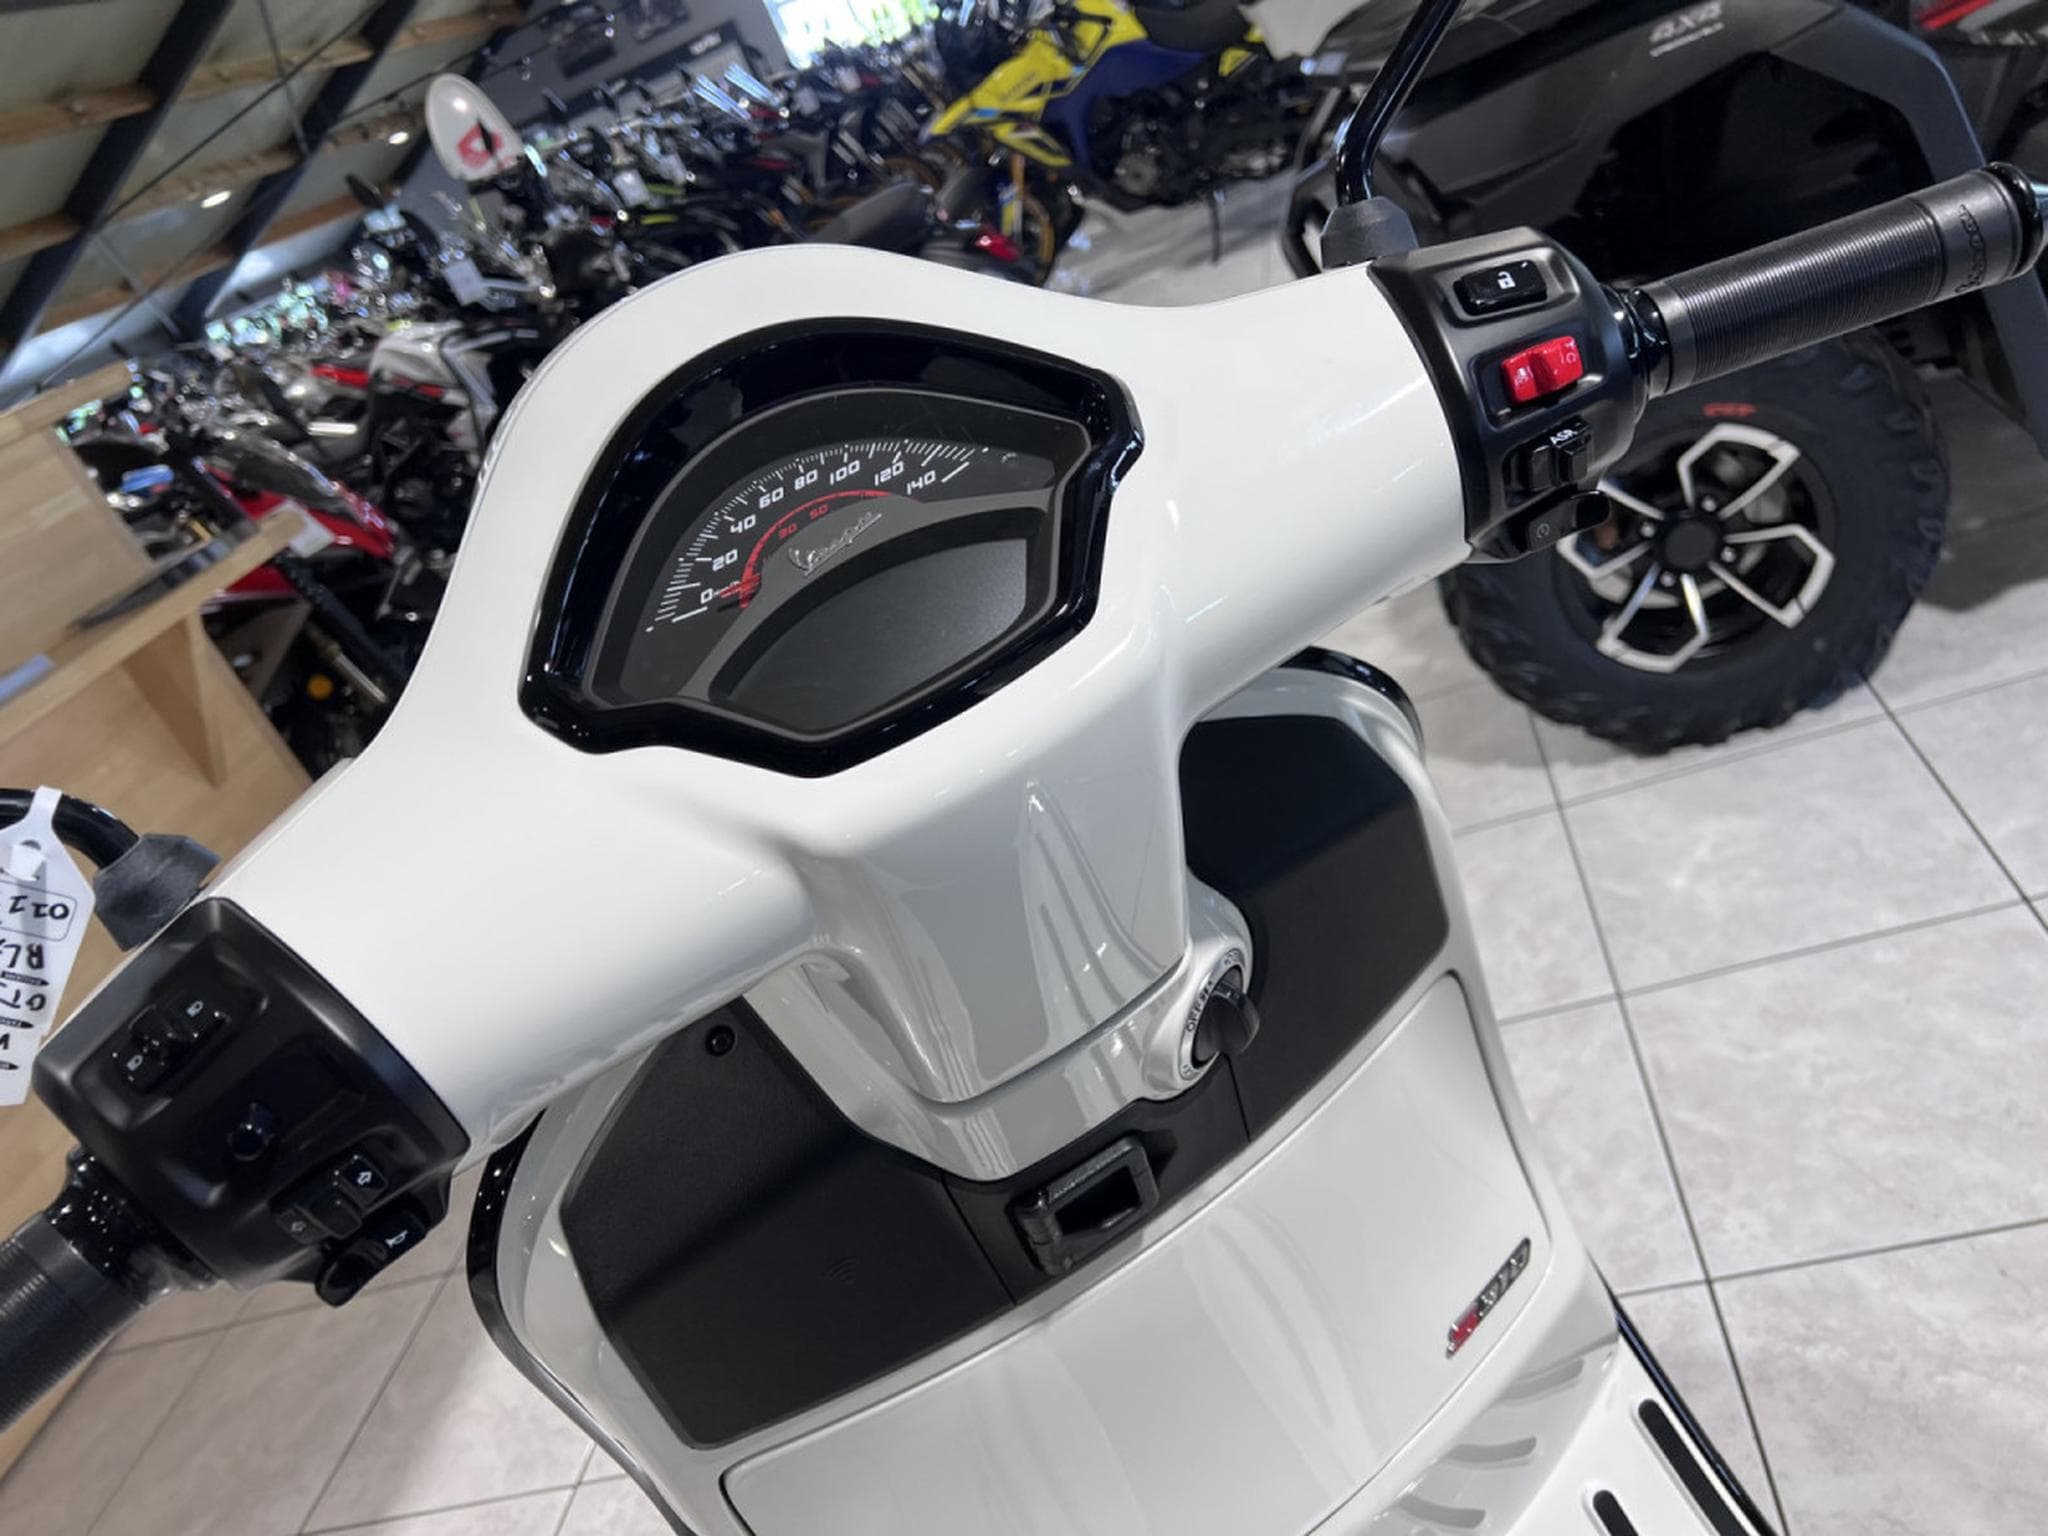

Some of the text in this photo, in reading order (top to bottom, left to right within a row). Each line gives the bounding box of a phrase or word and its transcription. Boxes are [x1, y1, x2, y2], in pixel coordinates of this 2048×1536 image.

[1550, 428, 1579, 446] ASR
[794, 469, 819, 491] 80
[829, 459, 861, 485] 100
[874, 460, 905, 487] 120
[906, 469, 937, 496] 140
[758, 486, 785, 509] 60
[808, 503, 830, 521] 50
[730, 513, 757, 534] 40
[712, 548, 738, 572] 20
[700, 587, 714, 604] 0
